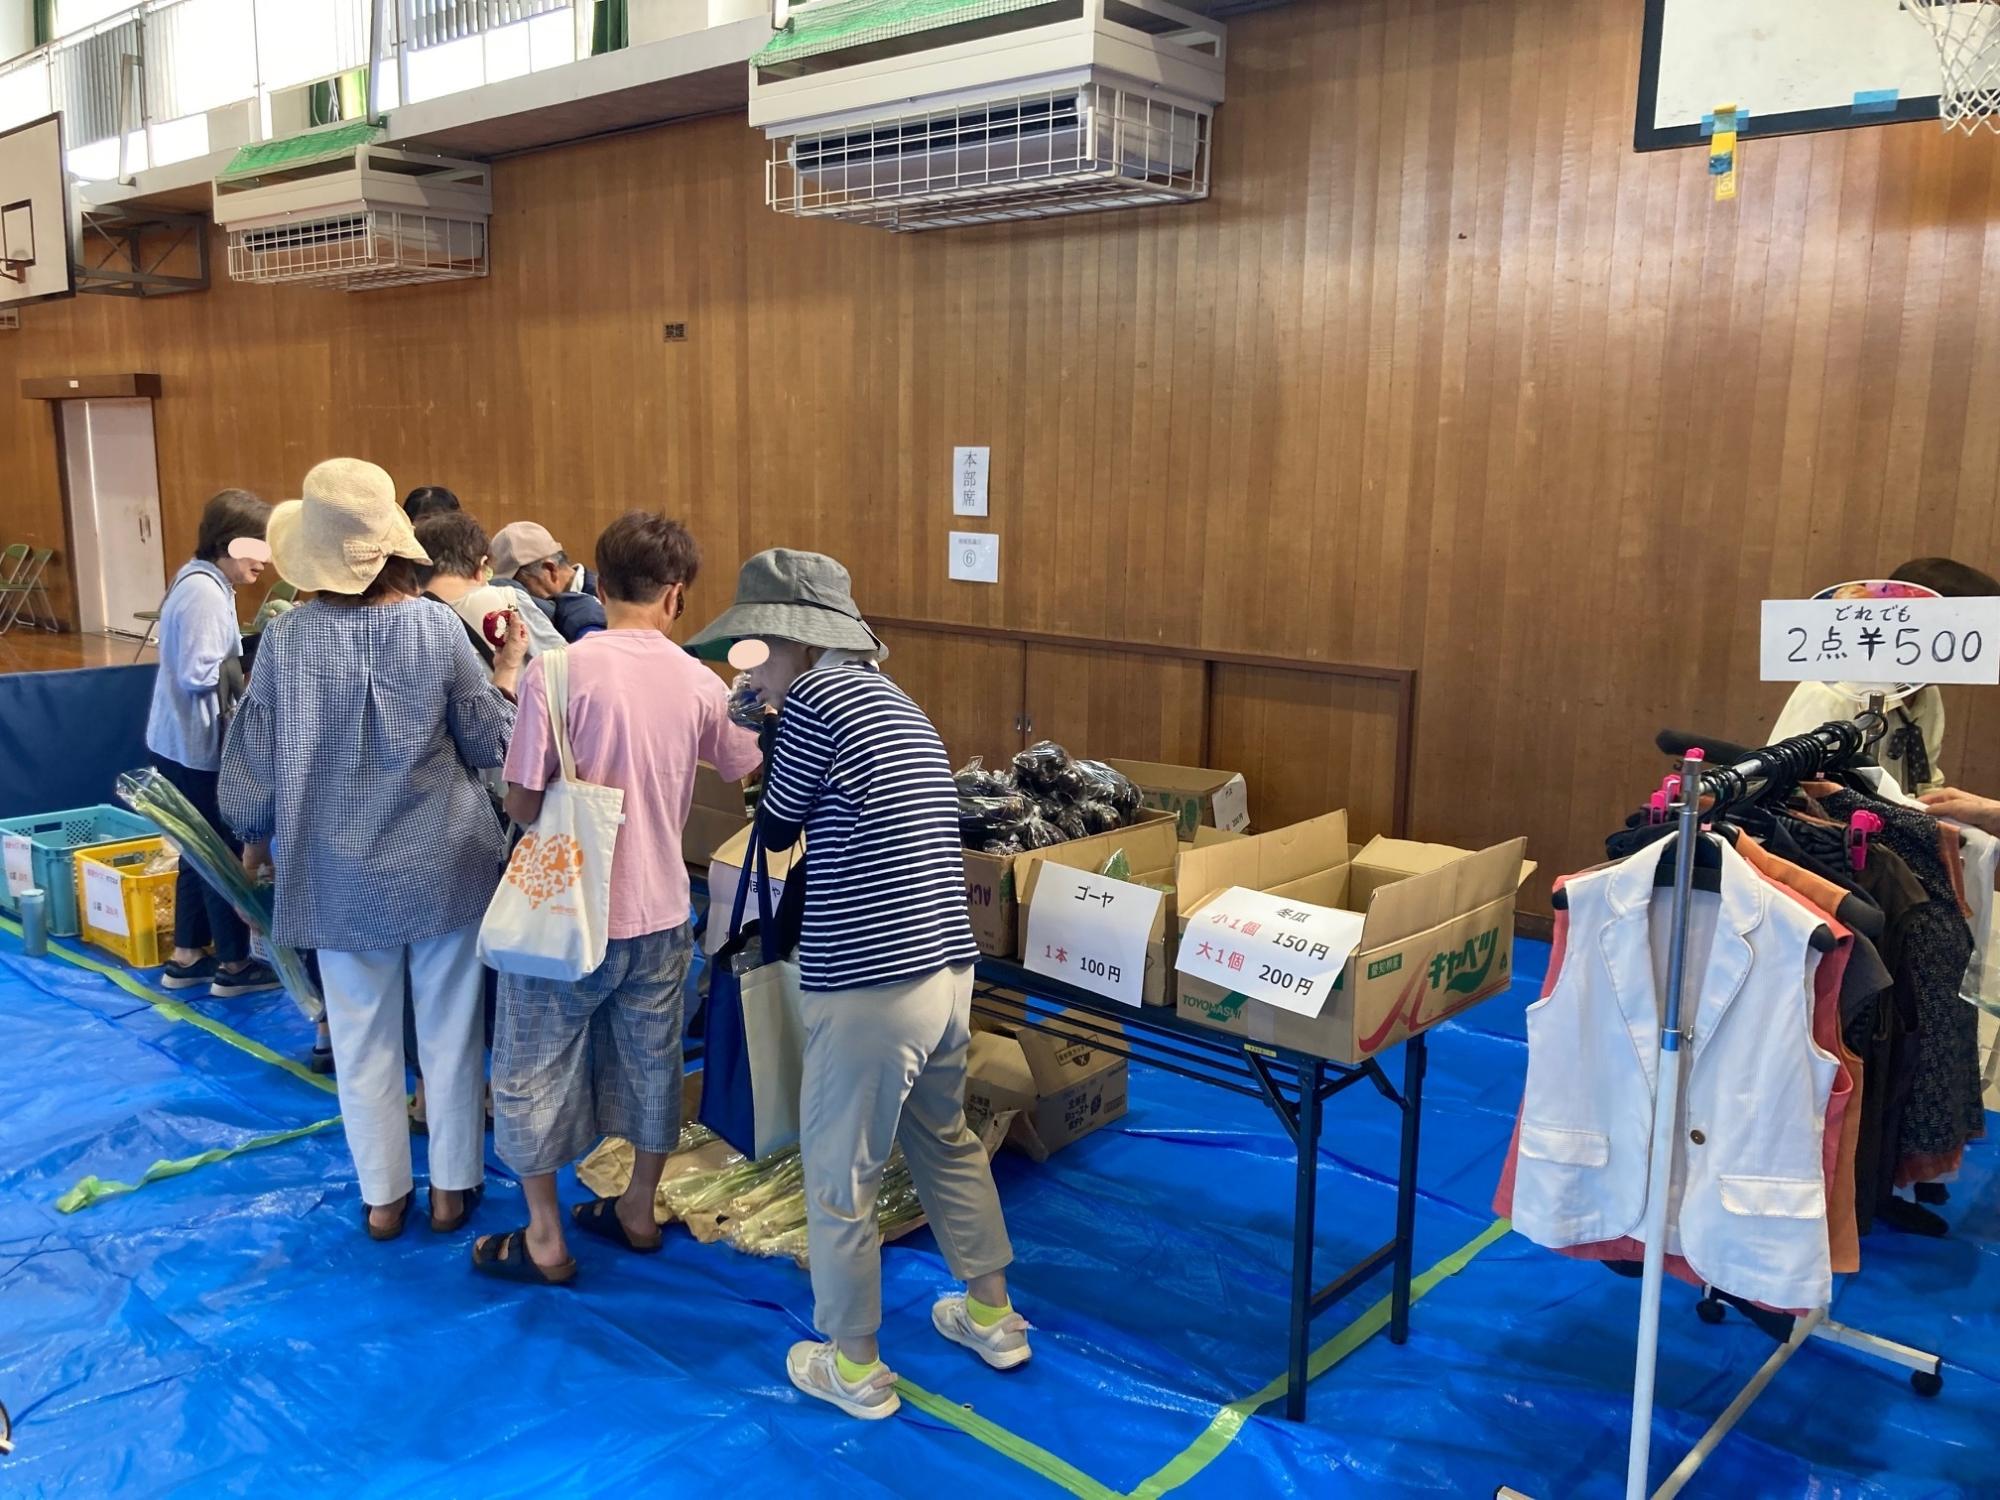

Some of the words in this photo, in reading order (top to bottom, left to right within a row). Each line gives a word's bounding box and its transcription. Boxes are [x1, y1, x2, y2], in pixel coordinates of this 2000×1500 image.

[962, 450, 978, 507] 本部席
[1835, 604, 1911, 623] どれでも
[1073, 885, 1115, 908] ゴーヤ
[1275, 907, 1311, 923] 冬瓜
[1211, 912, 1262, 937] 小1個
[1272, 931, 1330, 961] 150円
[1044, 944, 1069, 964] 1本
[1079, 956, 1122, 983] 100円
[1195, 940, 1246, 973] 大1個
[1257, 963, 1315, 997] 200円
[1427, 927, 1500, 993] キャベツ
[1183, 994, 1242, 1020] TOYOHASHI
